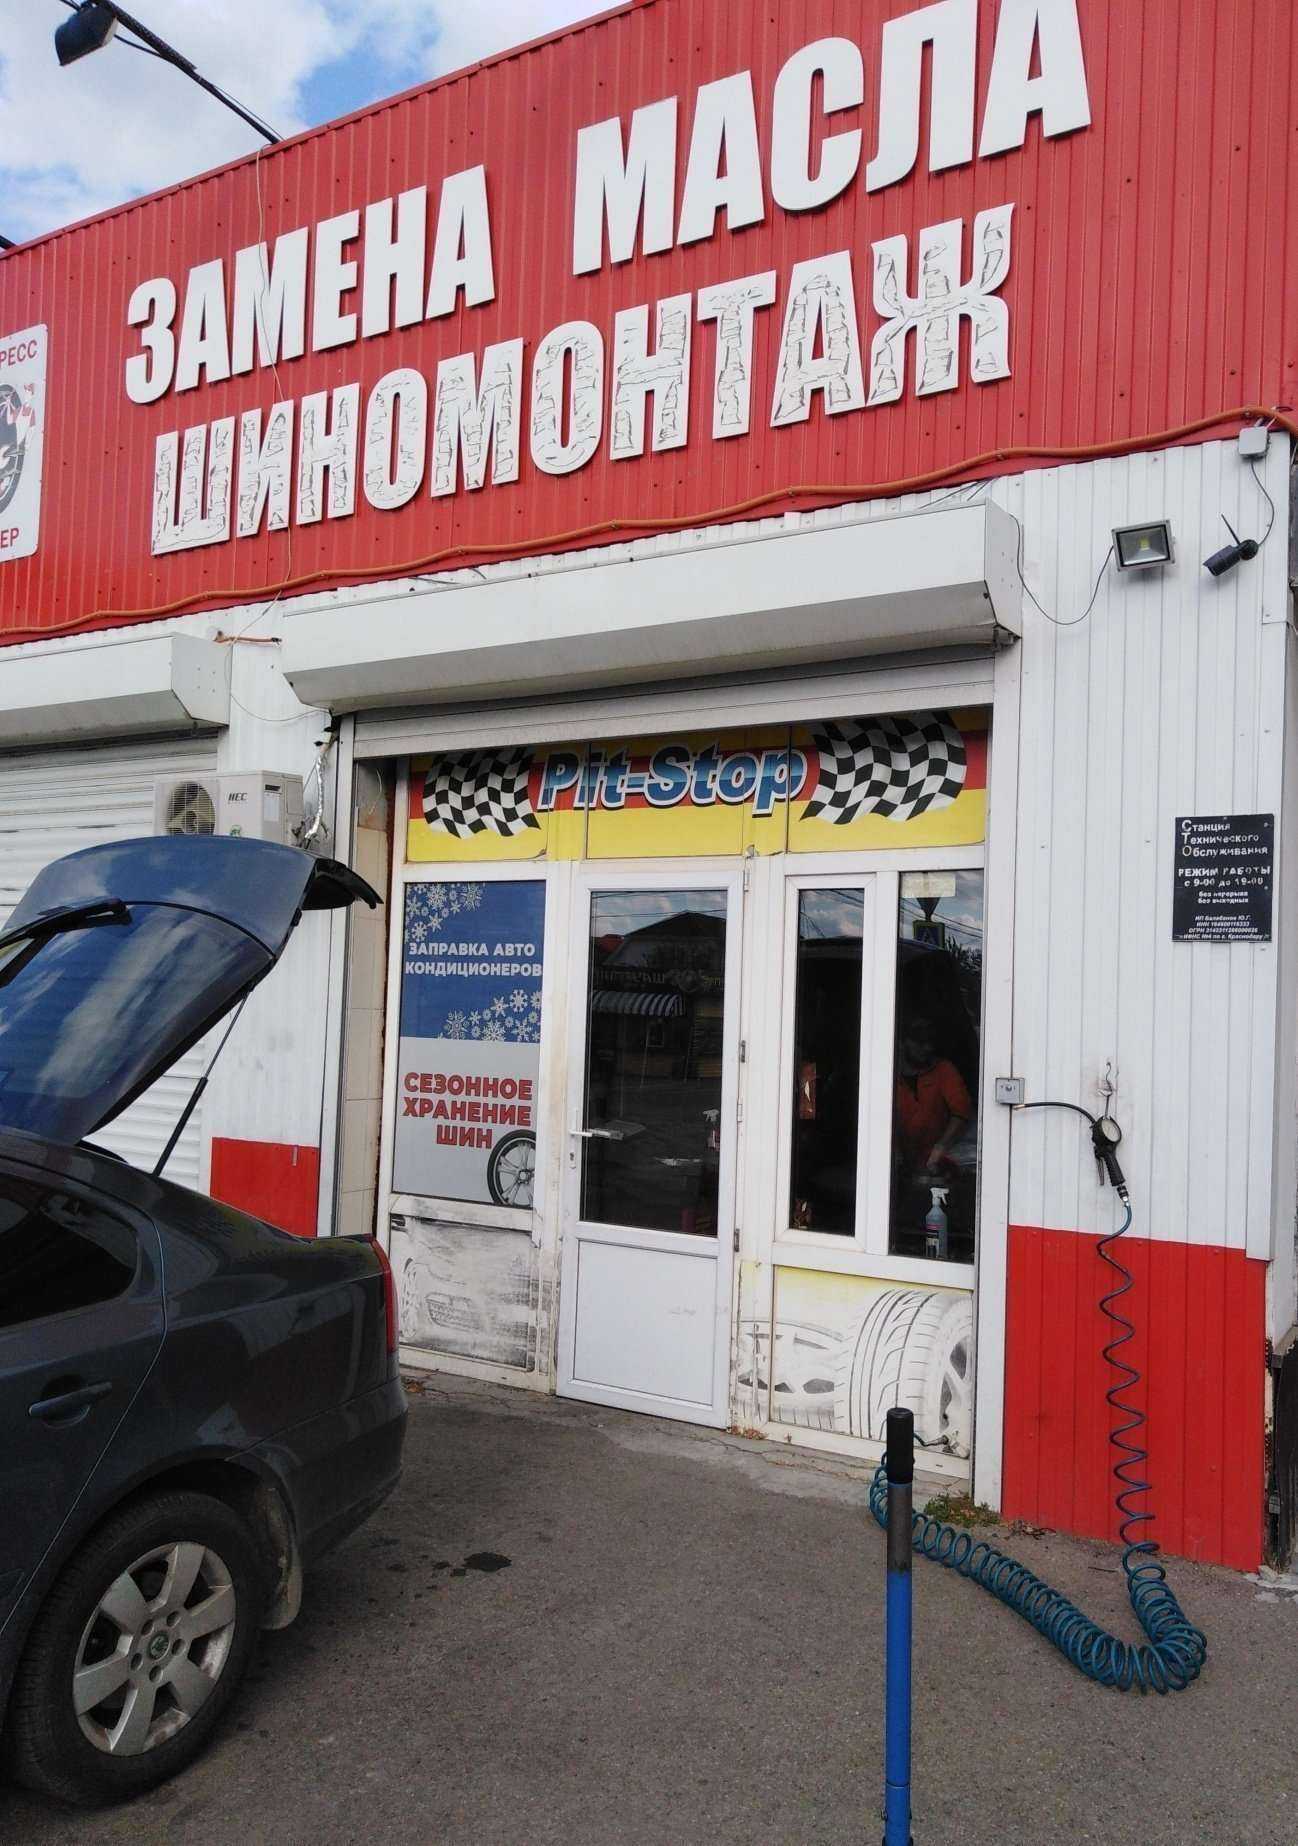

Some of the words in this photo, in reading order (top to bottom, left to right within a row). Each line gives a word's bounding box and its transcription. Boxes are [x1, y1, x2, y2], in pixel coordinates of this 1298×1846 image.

[124, 164, 496, 405] ЗАМЕНА
[572, 0, 1091, 277] МАСЛА
[151, 203, 1016, 556] ШИНОМОНТАЖ
[536, 743, 808, 817] Pit-Stop
[1181, 819, 1231, 832] Станция
[1181, 832, 1260, 845] Технического
[1182, 845, 1269, 858] Обслуживания
[1178, 867, 1219, 877] РЕЖИМ
[408, 942, 489, 956] ЗАПРАВКА
[493, 943, 536, 956] АВТО
[405, 961, 542, 977] КОНДИЦИОНЕРОВ
[404, 1072, 533, 1101] СЕЗОННОЕ
[403, 1096, 532, 1127] ХРАНЕНИЕ
[436, 1124, 493, 1149] ШИН
